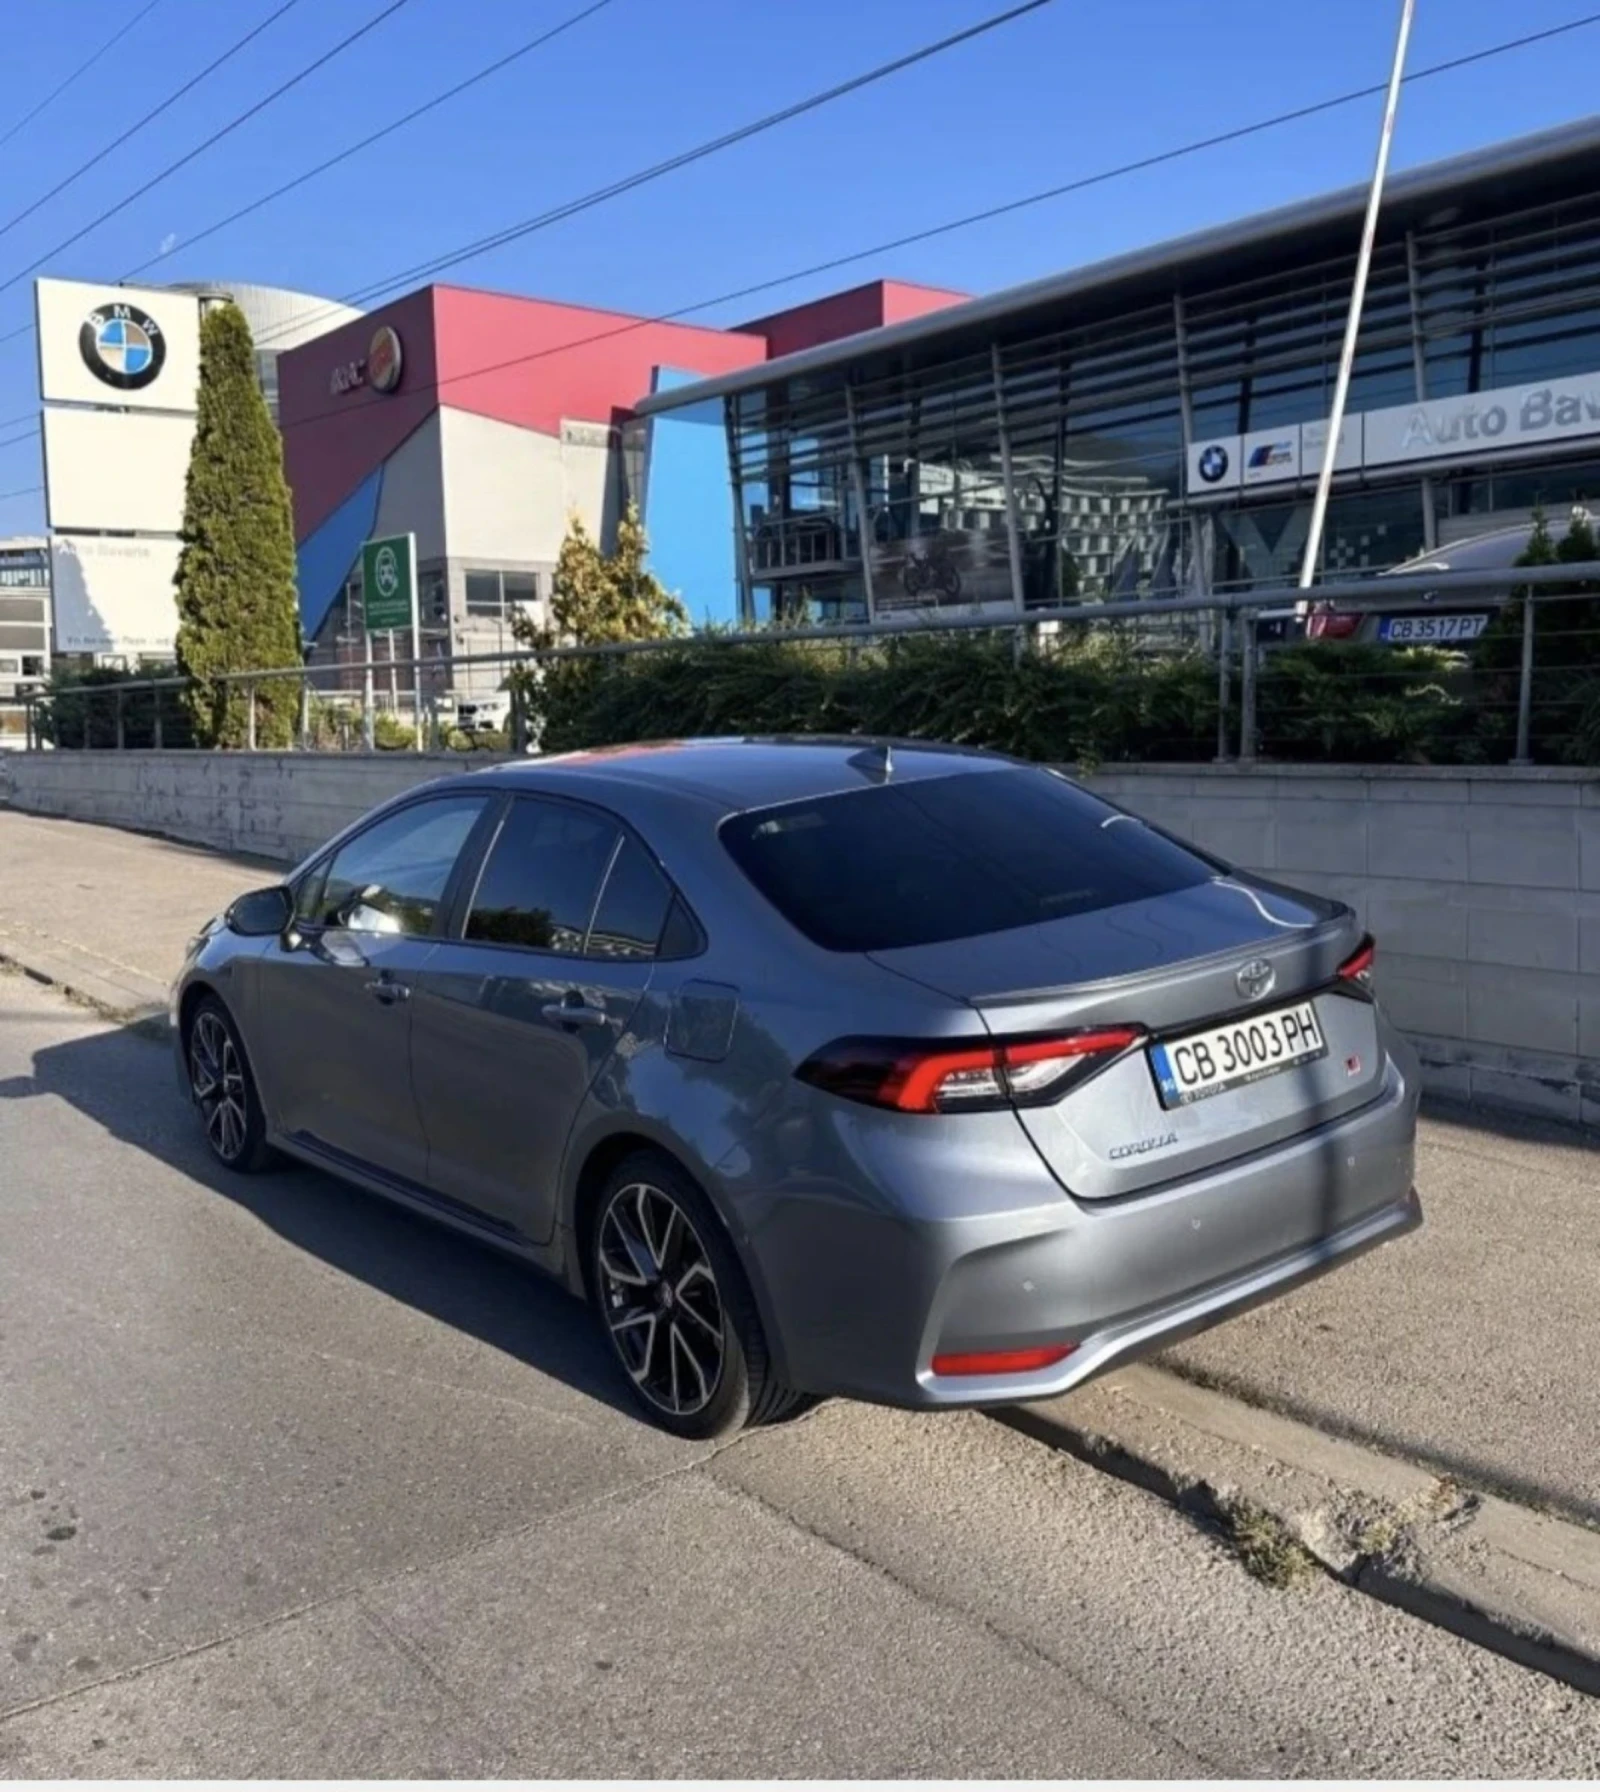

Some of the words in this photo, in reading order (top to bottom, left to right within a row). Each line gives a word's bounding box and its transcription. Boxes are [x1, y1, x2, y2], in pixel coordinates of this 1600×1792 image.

[1402, 404, 1507, 449] Auto
[1391, 620, 1413, 638] CB
[1415, 619, 1457, 638] 3517
[1174, 1041, 1217, 1085] CB
[1217, 1020, 1283, 1072] 3003
[1281, 1008, 1320, 1053] PH
